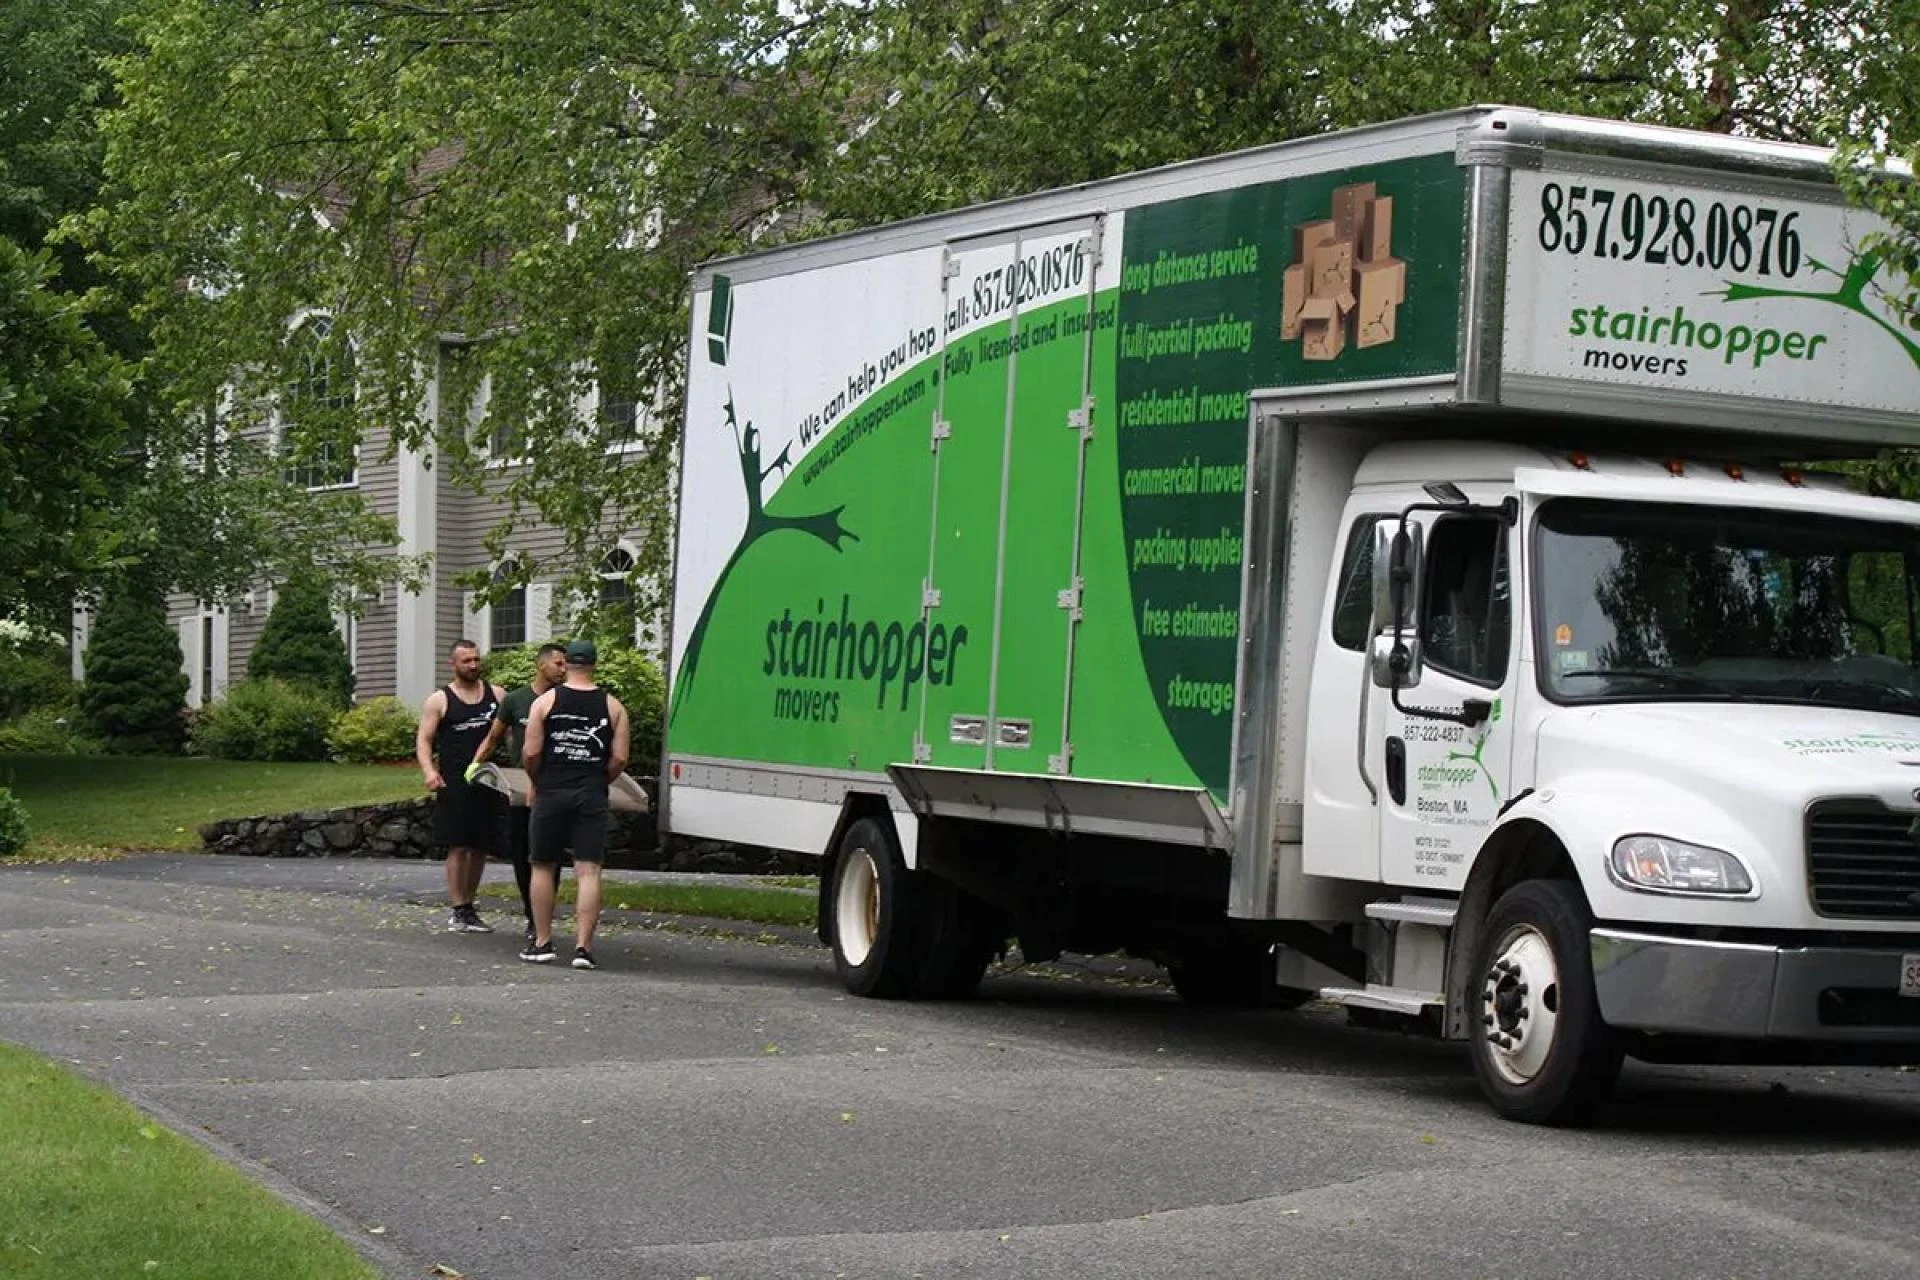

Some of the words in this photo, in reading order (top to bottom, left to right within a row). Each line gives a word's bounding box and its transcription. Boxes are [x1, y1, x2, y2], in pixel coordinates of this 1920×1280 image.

[1538, 182, 1801, 279] 857.928.0876
[1122, 254, 1150, 295] long
[1153, 248, 1208, 288] distance
[1209, 236, 1258, 279] service
[799, 412, 821, 448] We
[823, 391, 846, 425] can
[847, 360, 877, 403] help
[879, 342, 907, 384] you
[909, 325, 937, 359] hop
[972, 239, 1085, 321] 857.928.0876
[944, 344, 974, 381] Fully
[979, 322, 1030, 364] licensed
[1031, 312, 1058, 343] and
[1063, 298, 1116, 338] insured
[1194, 311, 1253, 360] packing
[1567, 303, 1828, 369] stairhopper
[1583, 348, 1689, 377] movers
[1121, 384, 1198, 428] residential
[1199, 390, 1248, 423] moves
[1125, 455, 1200, 496] commercial
[1201, 463, 1246, 494] moves
[1133, 526, 1187, 573] packing
[1189, 526, 1242, 573] supplies
[1143, 598, 1171, 637] free
[1172, 600, 1238, 638] estimates
[762, 593, 969, 712] stairhopper
[773, 686, 841, 724] movers
[1167, 672, 1234, 717] storage
[1403, 725, 1465, 743] 857-222-4837
[1418, 761, 1478, 789] stairhopper
[1416, 796, 1452, 816] Boston,
[1453, 799, 1469, 814] MA
